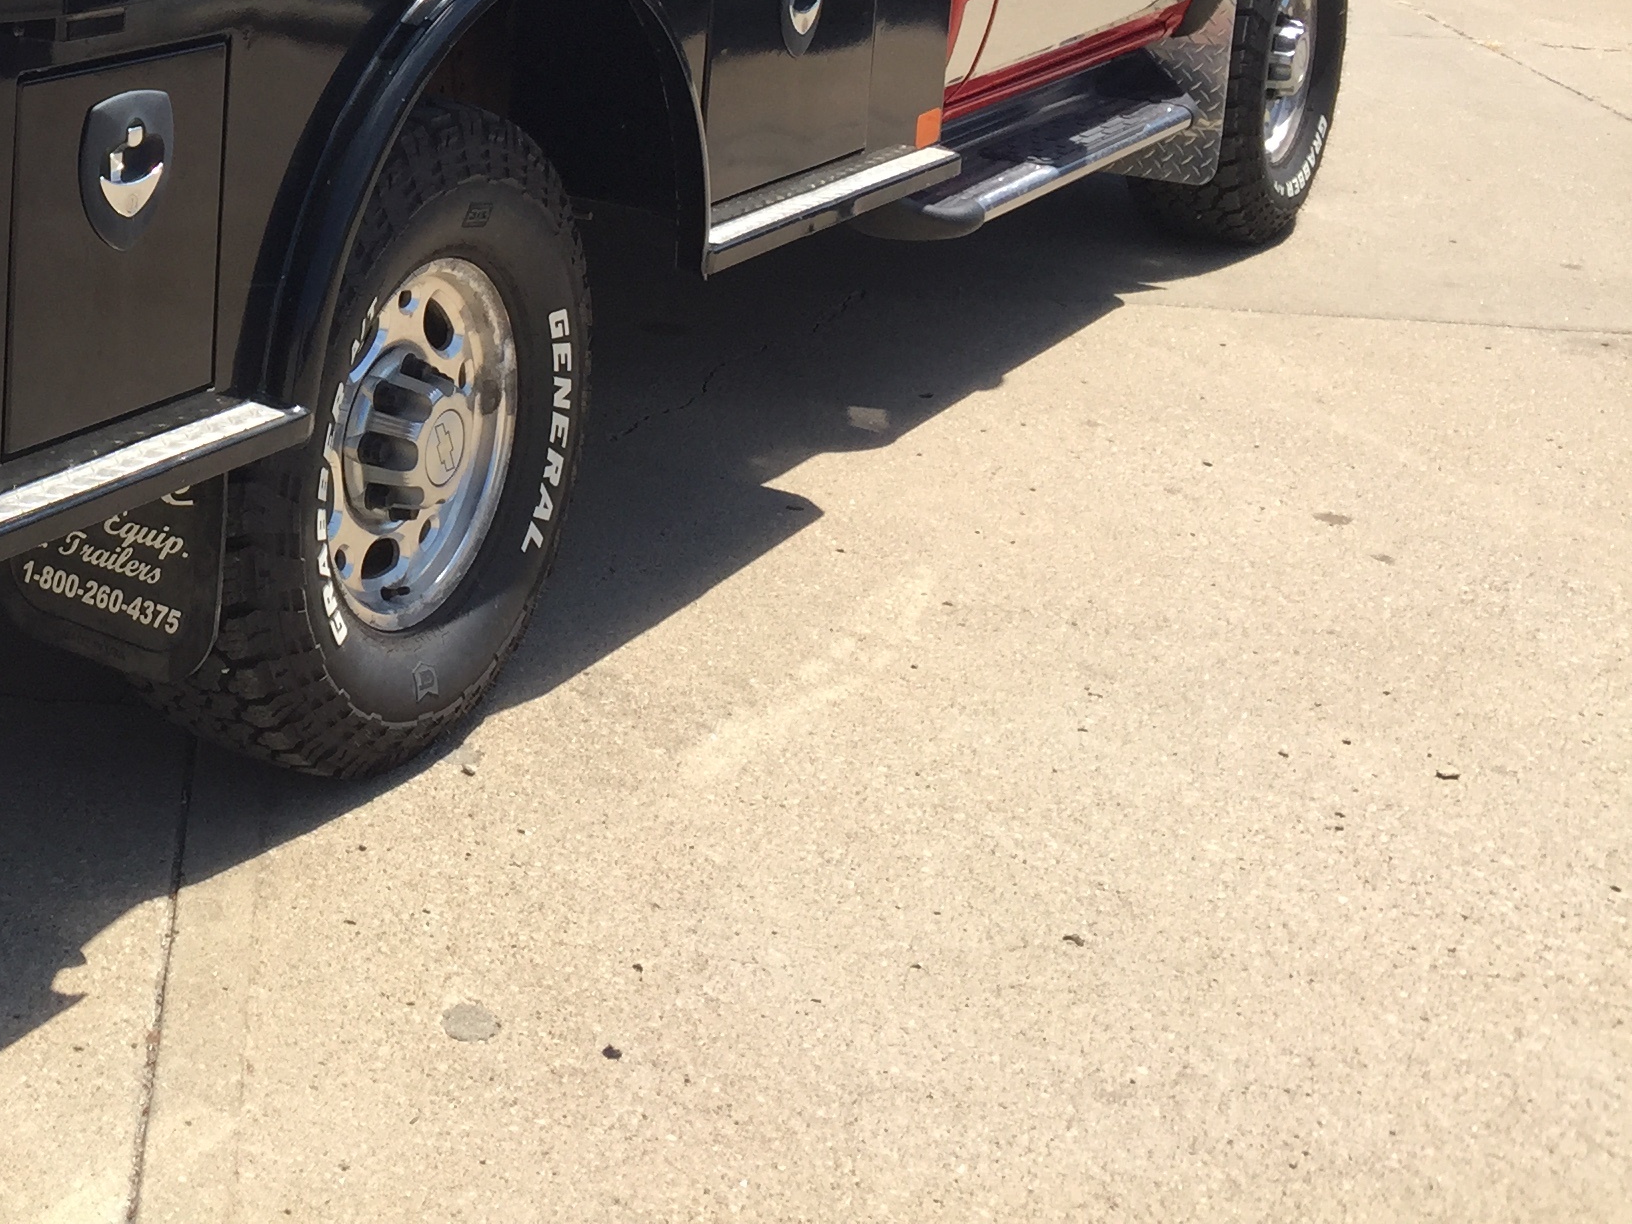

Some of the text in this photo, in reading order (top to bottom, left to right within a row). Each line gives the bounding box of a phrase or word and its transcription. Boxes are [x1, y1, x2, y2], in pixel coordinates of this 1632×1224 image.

[520, 308, 573, 553] GENERAL
[58, 531, 162, 584] Trailers
[103, 510, 189, 560] Equip.
[23, 560, 182, 634] 1-800-260-4375
